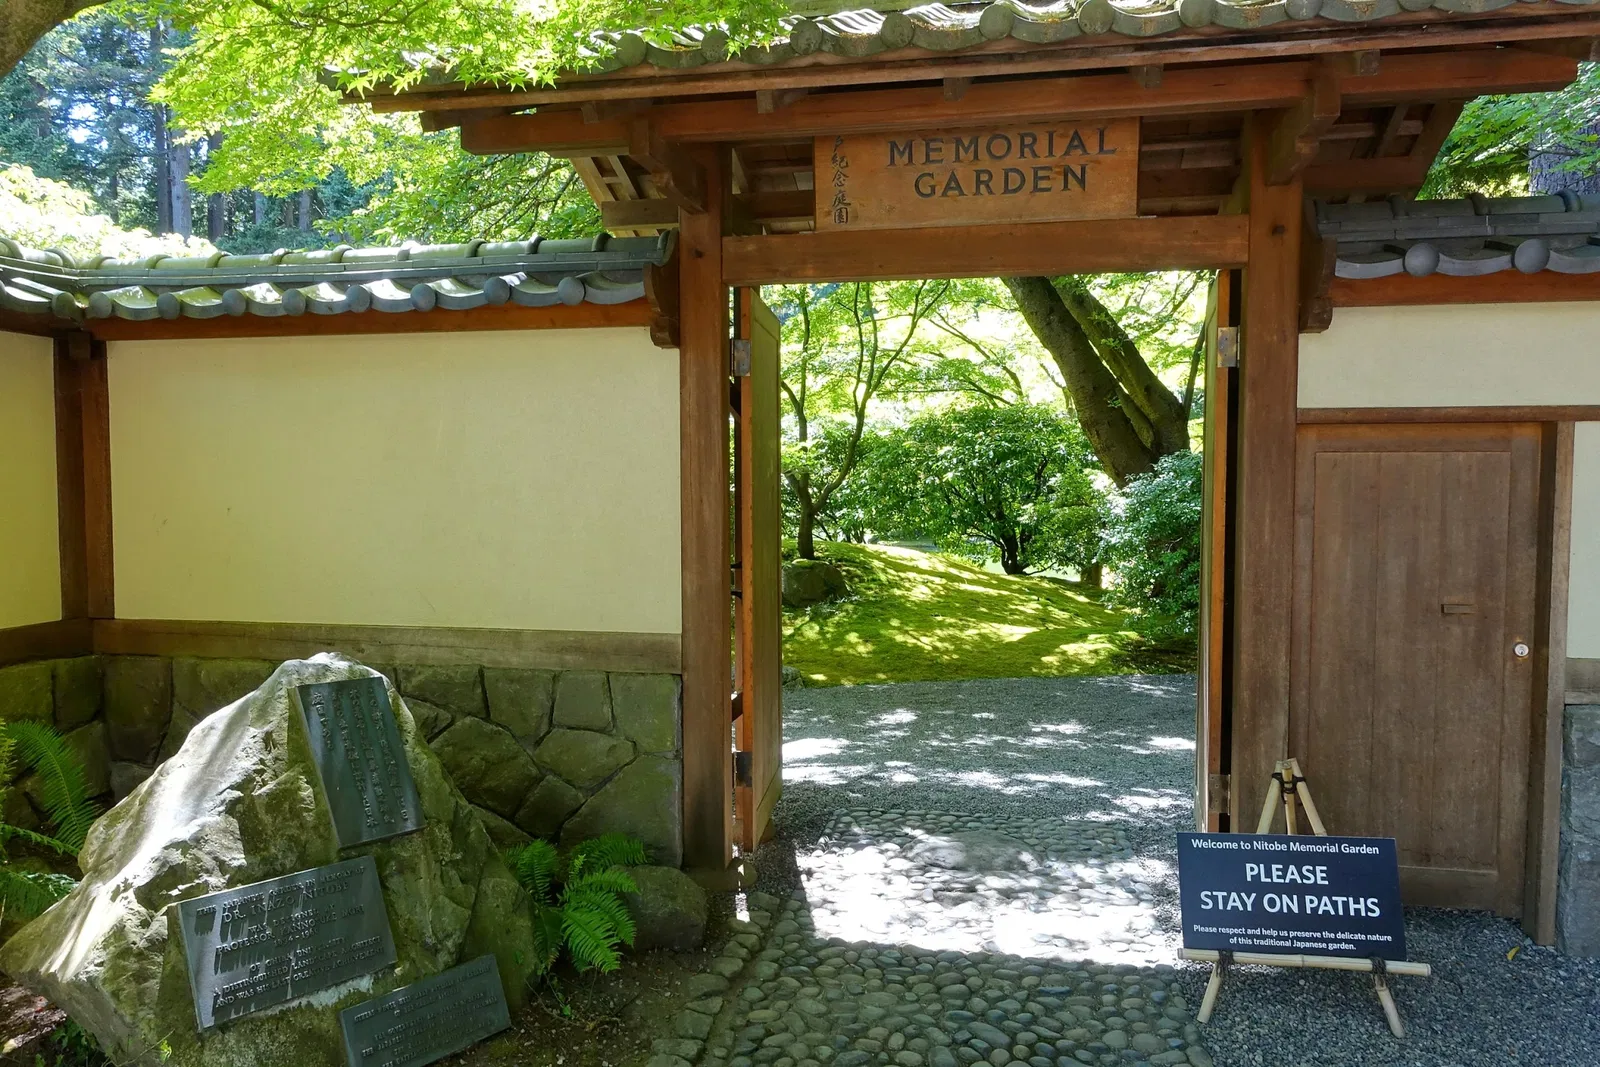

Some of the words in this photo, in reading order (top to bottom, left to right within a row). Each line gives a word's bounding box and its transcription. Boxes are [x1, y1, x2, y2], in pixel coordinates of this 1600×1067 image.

[886, 127, 1118, 168] MEMORIAL
[914, 164, 1088, 198] GARDEN
[1191, 839, 1238, 849] Welcome
[1240, 841, 1251, 849] to
[1253, 841, 1287, 851] Nitobe
[1290, 842, 1338, 852] Memorial
[1341, 844, 1379, 854] Garden
[1246, 863, 1328, 884] PLEASE
[1200, 891, 1256, 911] STAY
[1263, 893, 1298, 913] ON
[1305, 895, 1380, 917] PATHS
[222, 907, 247, 923] DR.
[216, 931, 275, 954] PROFESSOR
[1194, 924, 1217, 933] Please
[1219, 927, 1246, 935] respect
[1262, 928, 1278, 937] help
[1289, 931, 1321, 939] preserve
[1336, 932, 1366, 940] delicate
[1254, 937, 1292, 946] traditional
[1293, 940, 1327, 948] Japanese
[1328, 942, 1356, 950] garden.
[214, 994, 235, 1008] AND
[236, 987, 254, 1000] WAS
